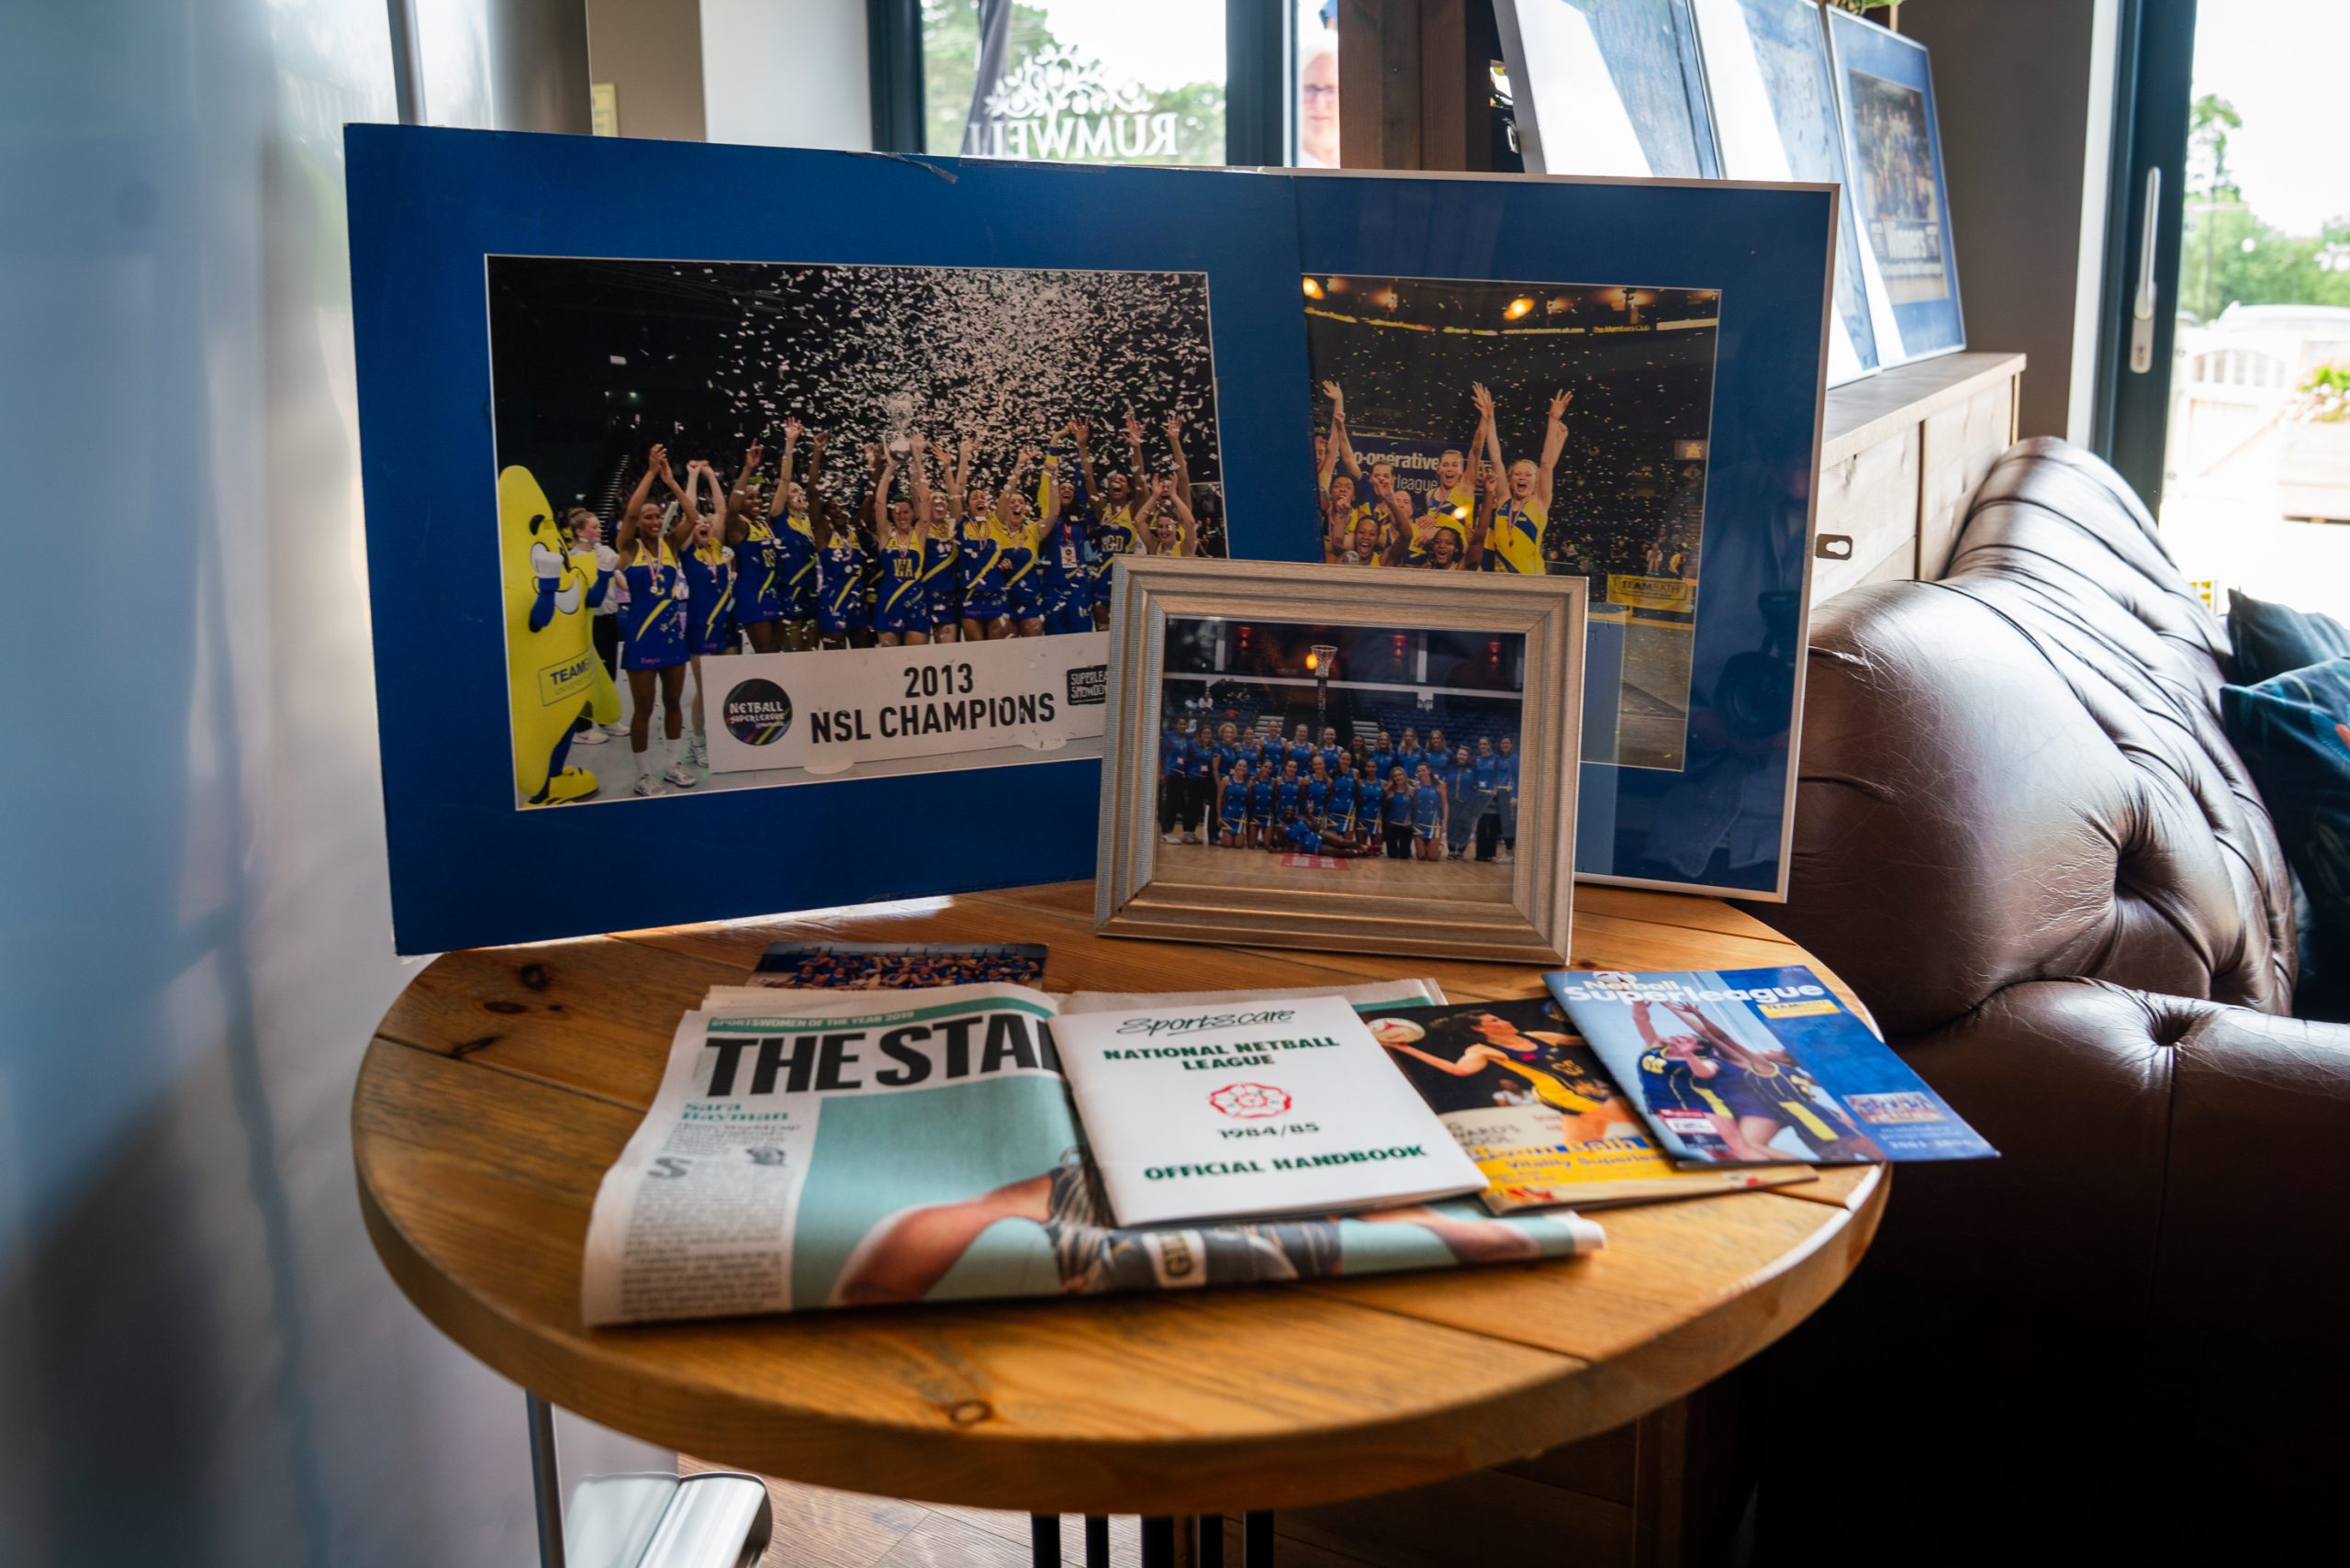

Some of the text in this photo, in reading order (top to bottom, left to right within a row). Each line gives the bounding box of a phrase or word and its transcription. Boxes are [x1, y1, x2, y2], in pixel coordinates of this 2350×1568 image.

[904, 663, 974, 698] 2013
[730, 700, 784, 714] NETBALL
[811, 692, 1055, 743] NSL CHAMPIONS
[1563, 984, 1825, 1005] Superleague
[1582, 980, 1681, 991] Netball
[808, 1019, 823, 1027] OF
[826, 1017, 848, 1026] THE
[851, 1015, 882, 1025] YEAR
[884, 1011, 915, 1022] 2019
[1116, 1009, 1295, 1036] Sportscare
[1103, 1036, 1340, 1061] NATIONAL NETBALL
[705, 1033, 867, 1097] THE
[1181, 1054, 1275, 1071] LEAGUE
[1217, 1122, 1321, 1140] 1984/85
[1144, 1144, 1427, 1181] OFFICIAL HANDBOOK
